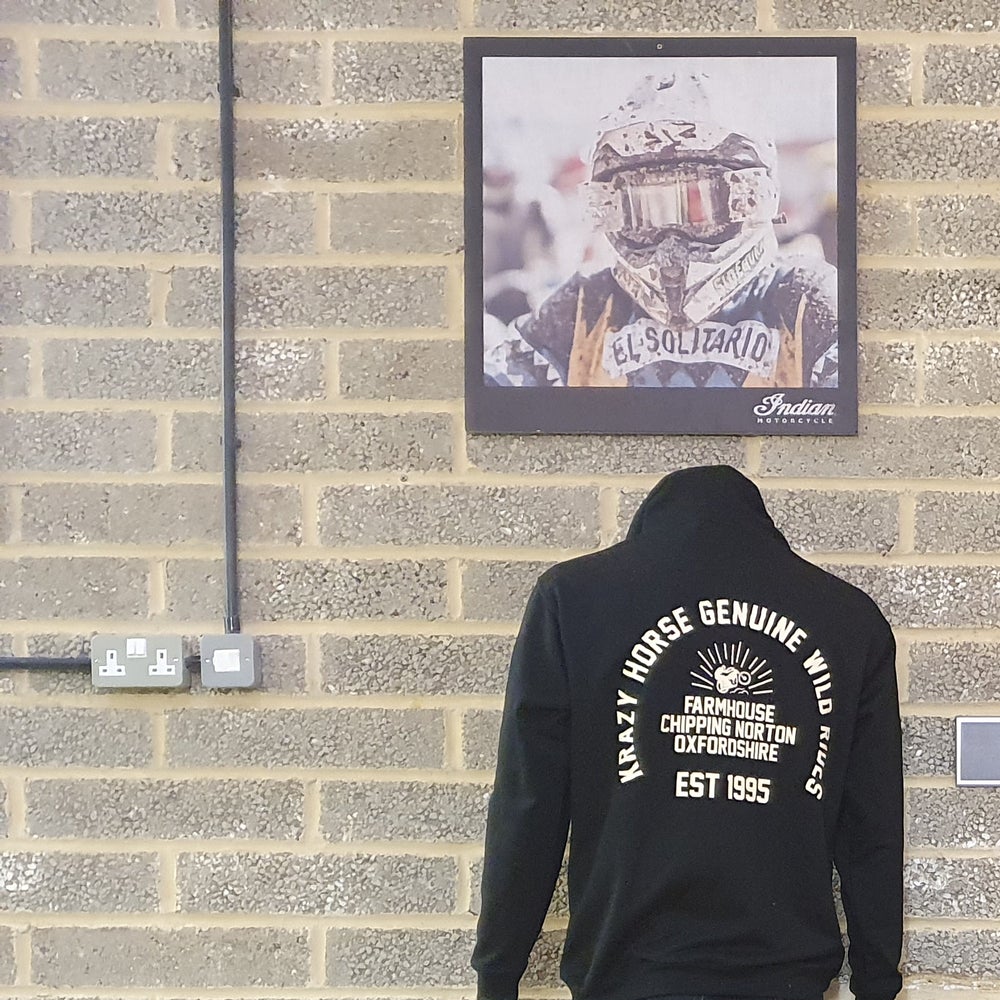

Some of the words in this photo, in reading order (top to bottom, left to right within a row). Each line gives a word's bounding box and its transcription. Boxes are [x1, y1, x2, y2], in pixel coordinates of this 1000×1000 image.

[612, 333, 641, 366] EL
[645, 326, 768, 364] SOLITARIO
[753, 392, 836, 416] Indian
[756, 417, 833, 425] MOTORCYCLE
[698, 598, 808, 653] GENUINE
[622, 606, 695, 684] HORSE
[803, 648, 833, 715] WILD
[684, 695, 775, 723] FARMHOUSE
[616, 689, 644, 784] KRAZY
[660, 714, 731, 736] CHIPPING
[734, 720, 797, 745] NORTON
[674, 734, 779, 762] OXFORDSHIRE
[675, 771, 720, 799] EST
[726, 774, 771, 804] 1995
